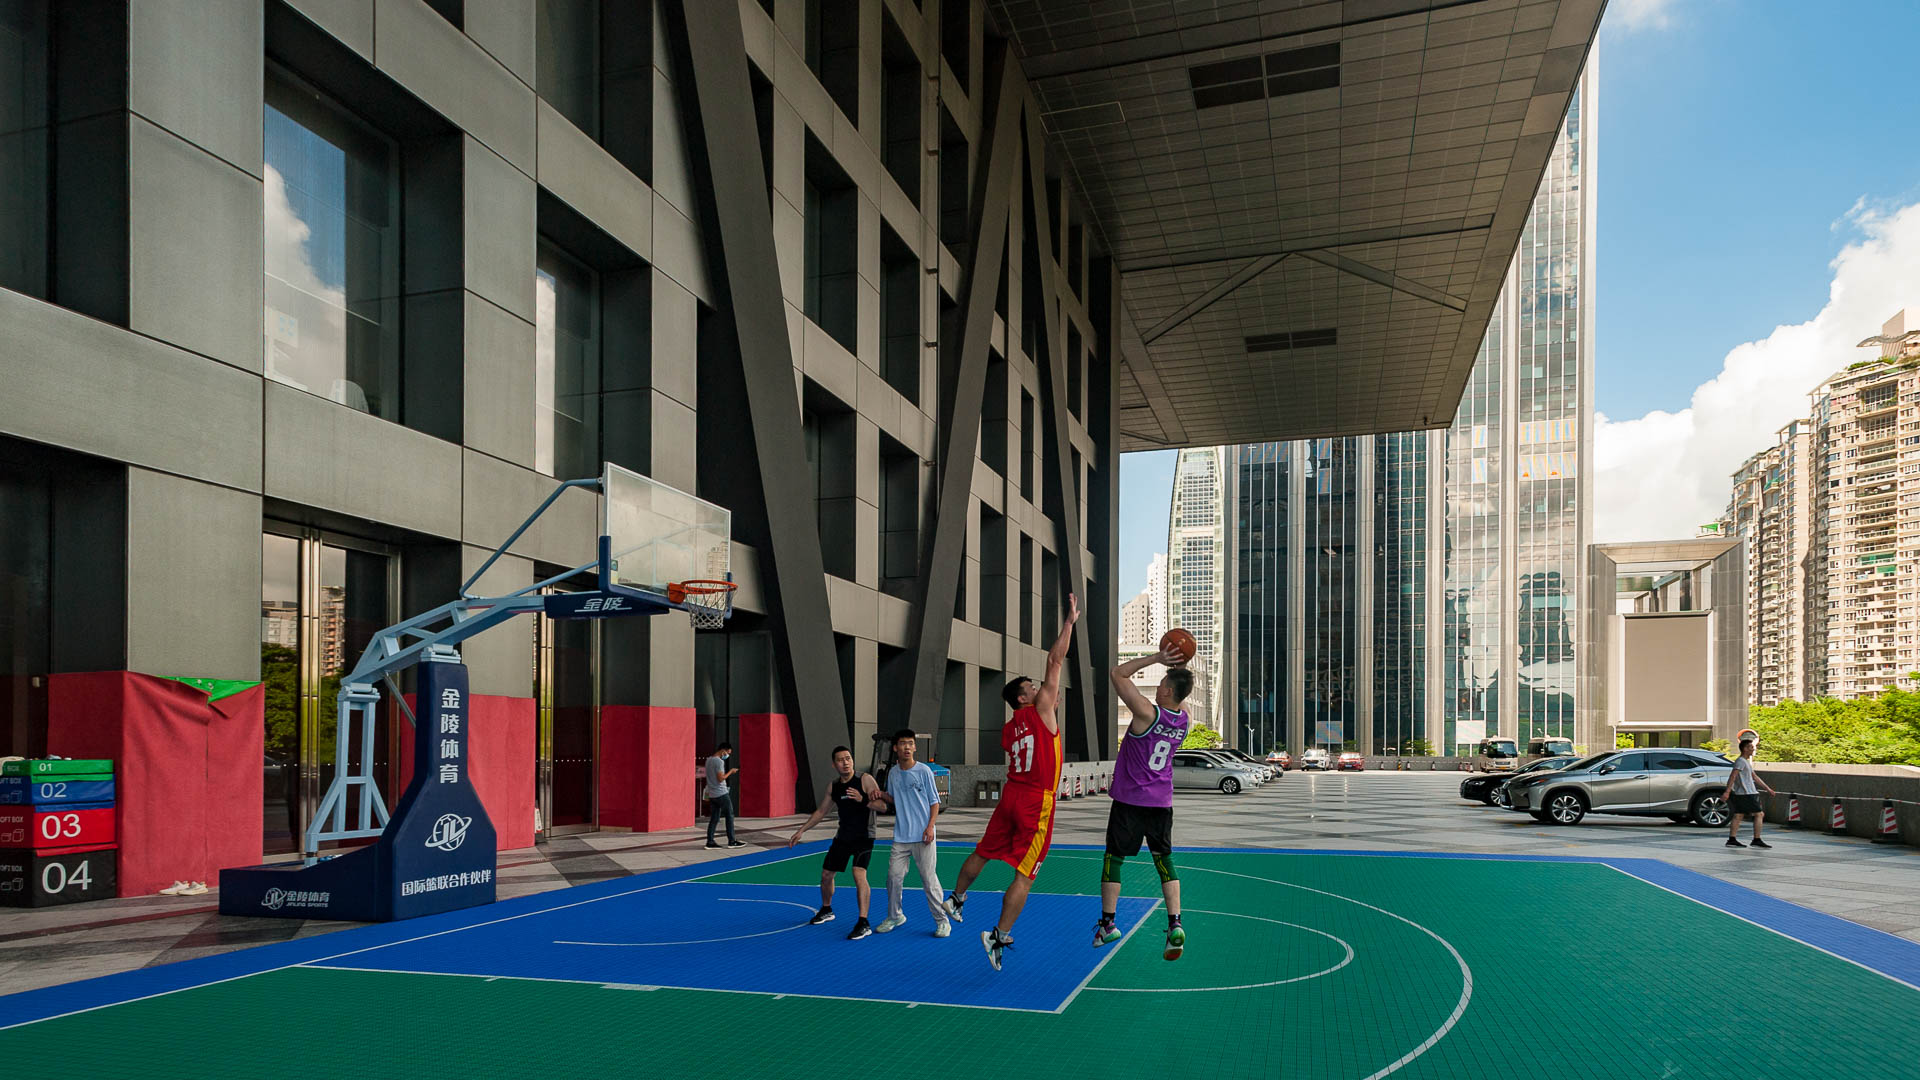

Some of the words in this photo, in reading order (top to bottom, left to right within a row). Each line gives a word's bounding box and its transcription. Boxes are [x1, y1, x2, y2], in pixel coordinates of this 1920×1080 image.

[574, 597, 632, 612] 金陵
[440, 688, 460, 784] 金陵体育
[1154, 724, 1184, 740] SZSE
[1148, 740, 1171, 771] 8
[39, 762, 52, 771] 01
[40, 782, 67, 798] 02
[12, 815, 24, 823] BOX
[41, 813, 82, 839] 03
[11, 864, 23, 873] BOX
[42, 860, 92, 893] 04
[401, 869, 492, 896] 国际篮联合作伙伴
[286, 890, 332, 903] 金陵体育
